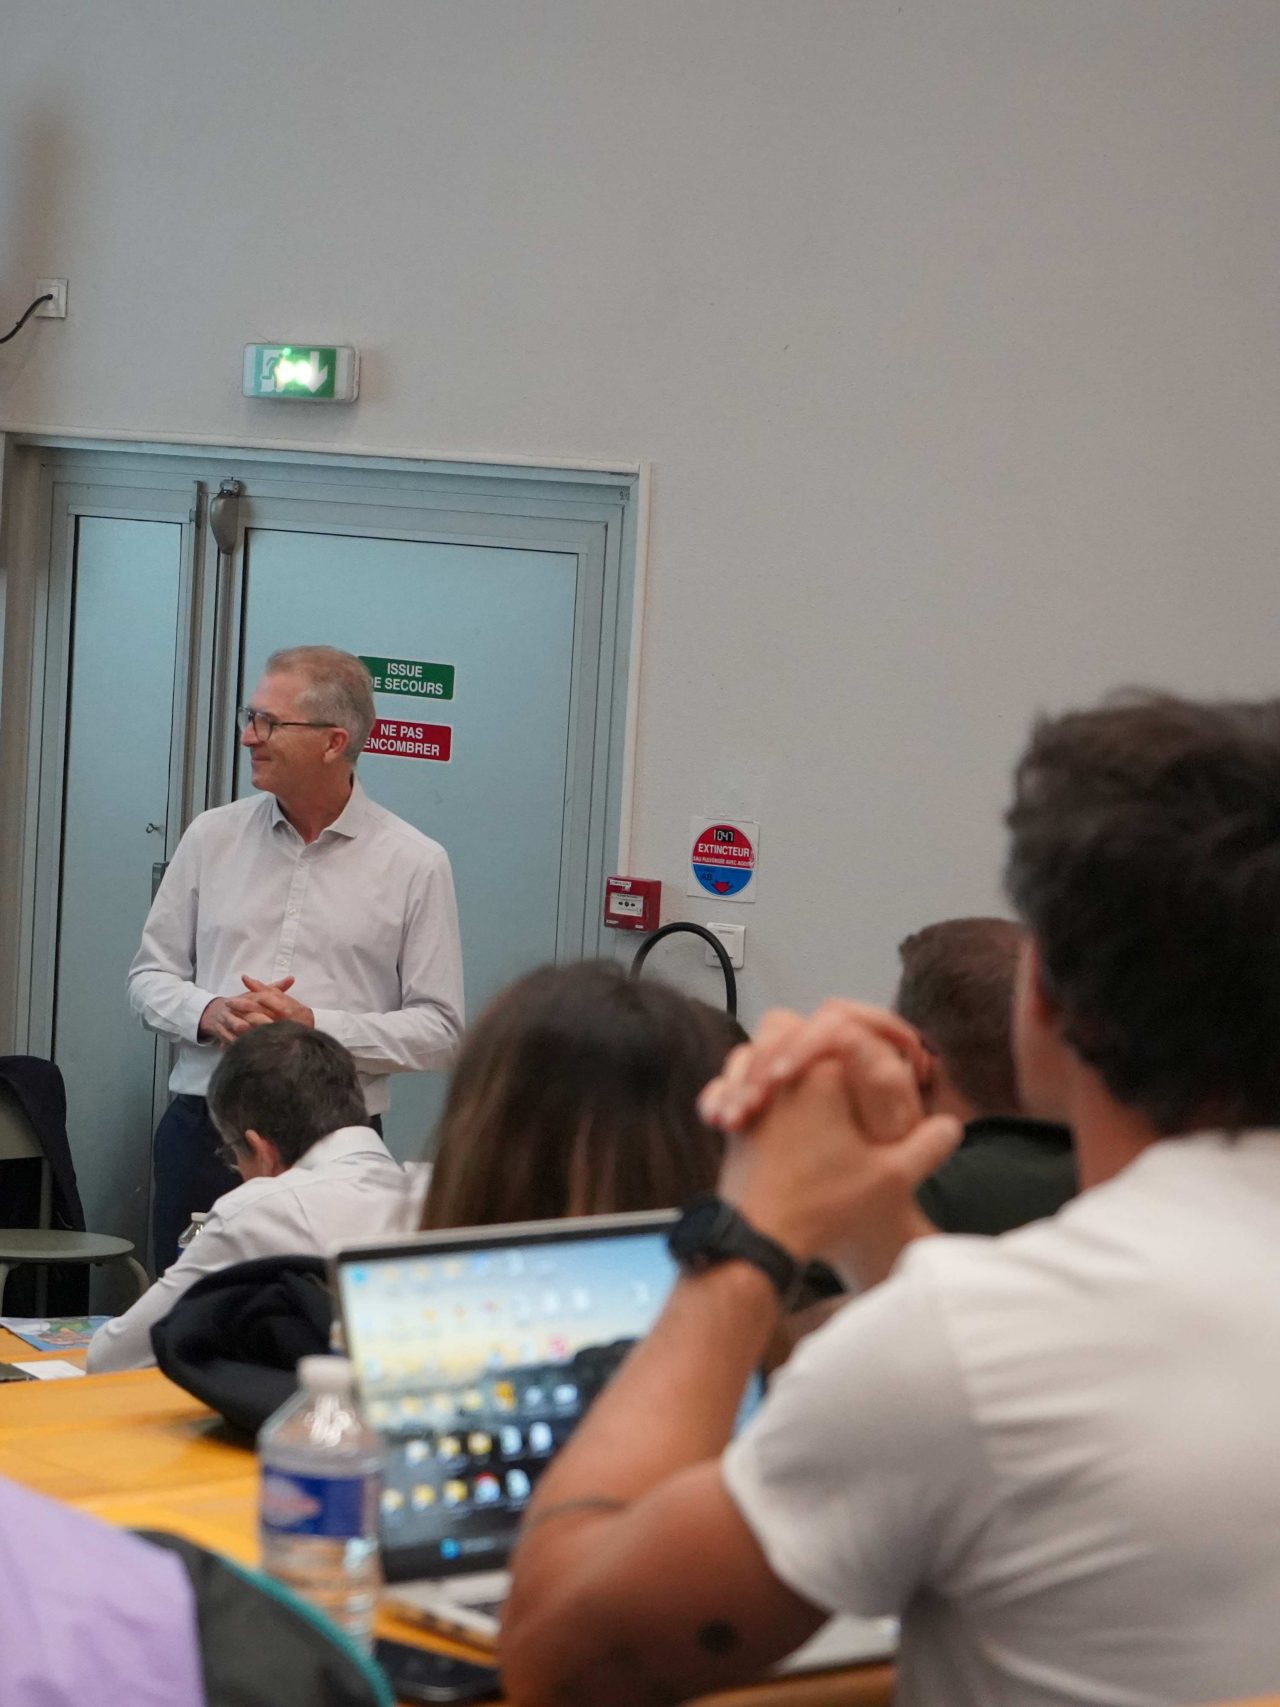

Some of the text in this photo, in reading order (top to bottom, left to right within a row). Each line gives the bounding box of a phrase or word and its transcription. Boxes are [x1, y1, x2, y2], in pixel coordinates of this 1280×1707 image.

[387, 662, 423, 678] ISSUE
[384, 678, 443, 695] SECOURS
[380, 723, 424, 740] NE PAS
[698, 844, 750, 857] EXTINCTEUR
